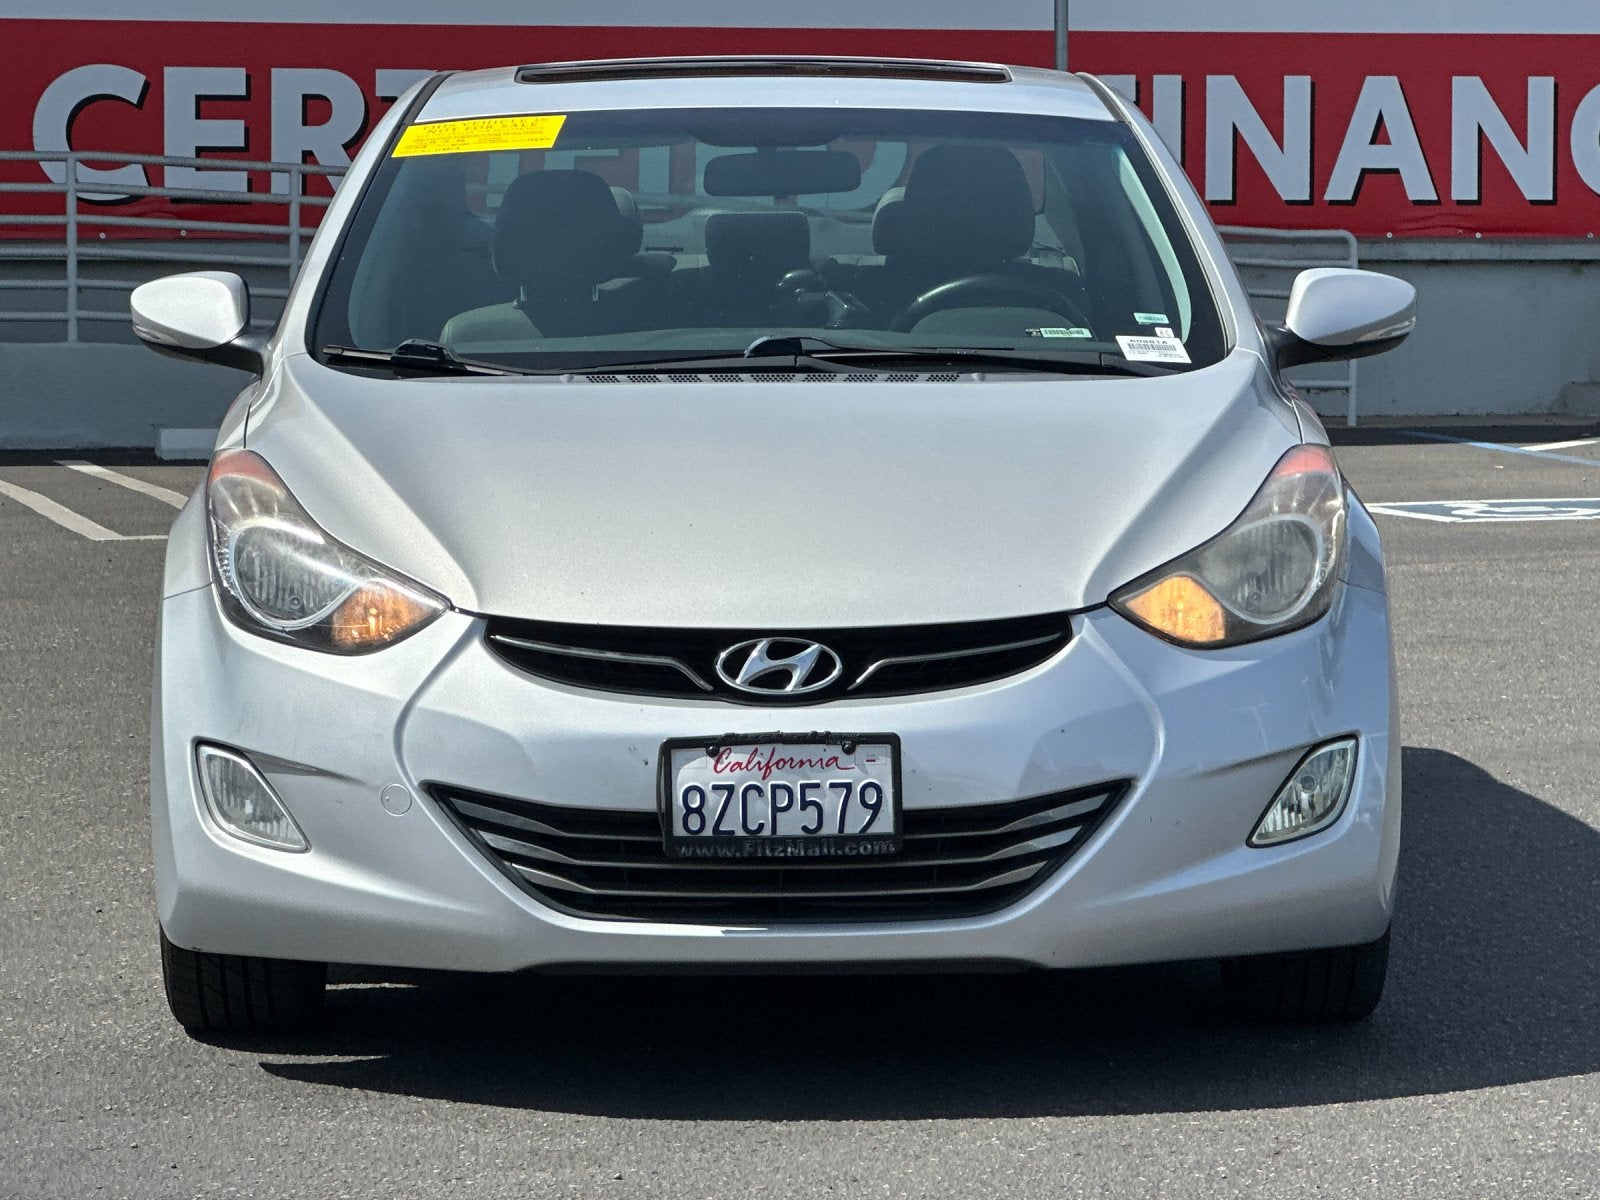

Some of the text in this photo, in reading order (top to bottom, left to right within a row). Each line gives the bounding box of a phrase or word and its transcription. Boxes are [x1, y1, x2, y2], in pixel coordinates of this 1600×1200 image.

[713, 746, 855, 780] California
[682, 782, 883, 836] 8ZCP579
[677, 839, 896, 858] www.FitzMall.com
